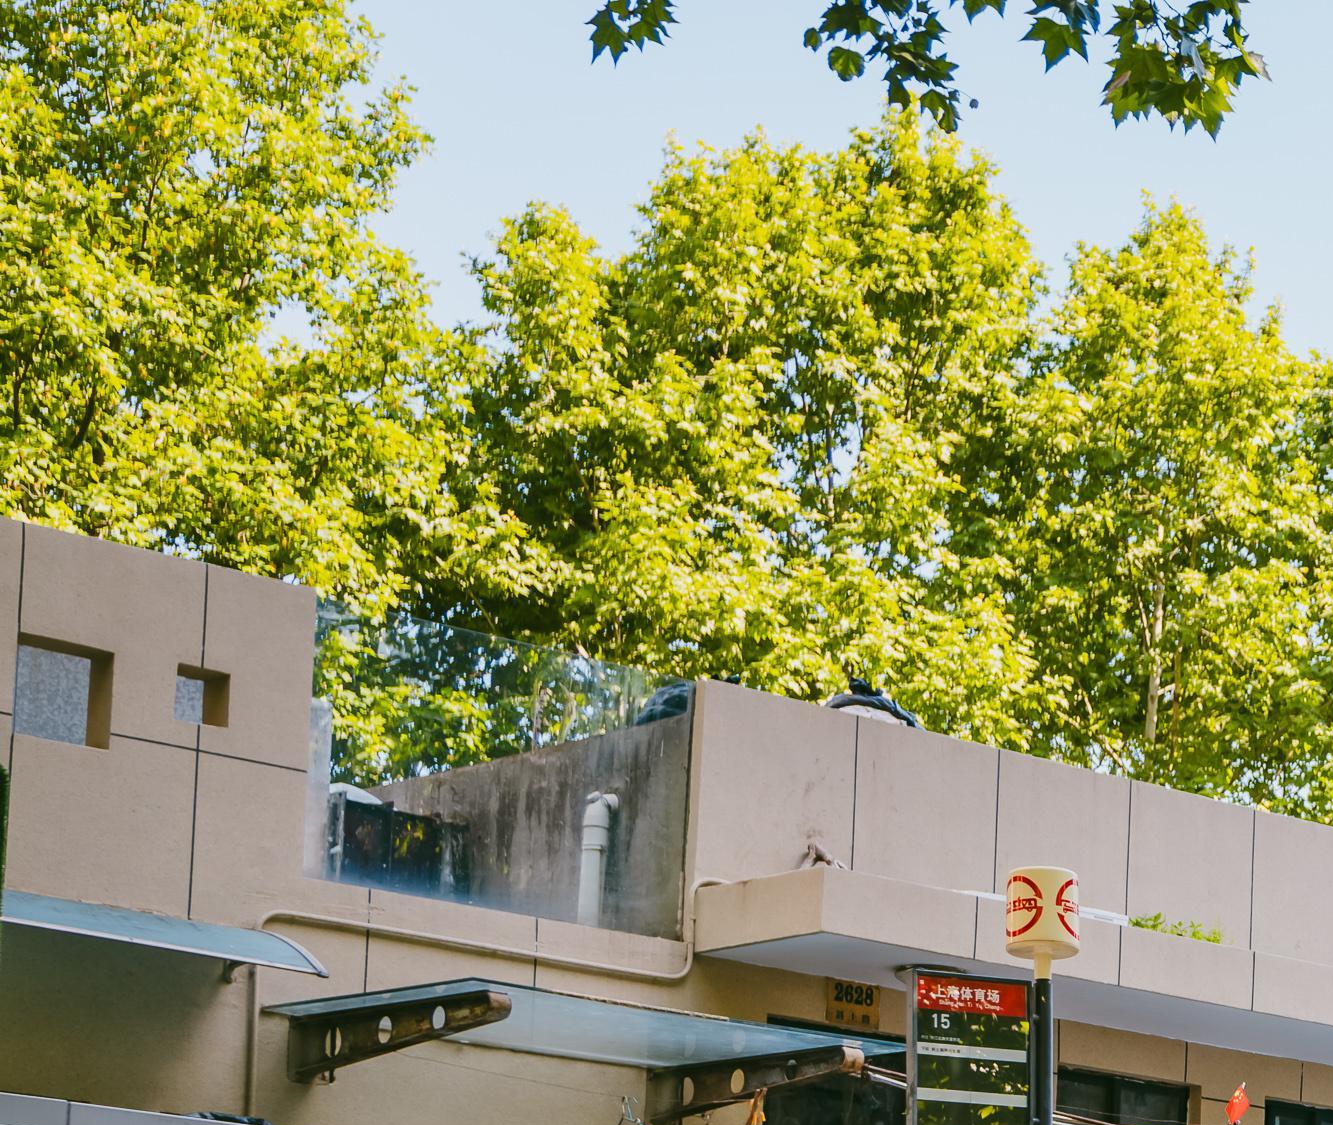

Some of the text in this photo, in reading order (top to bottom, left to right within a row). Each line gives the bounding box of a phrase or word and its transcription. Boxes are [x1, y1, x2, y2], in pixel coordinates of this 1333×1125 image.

[834, 982, 874, 1007] 2628
[934, 984, 1000, 1003] 上海体育场
[932, 1013, 951, 1029] 15
